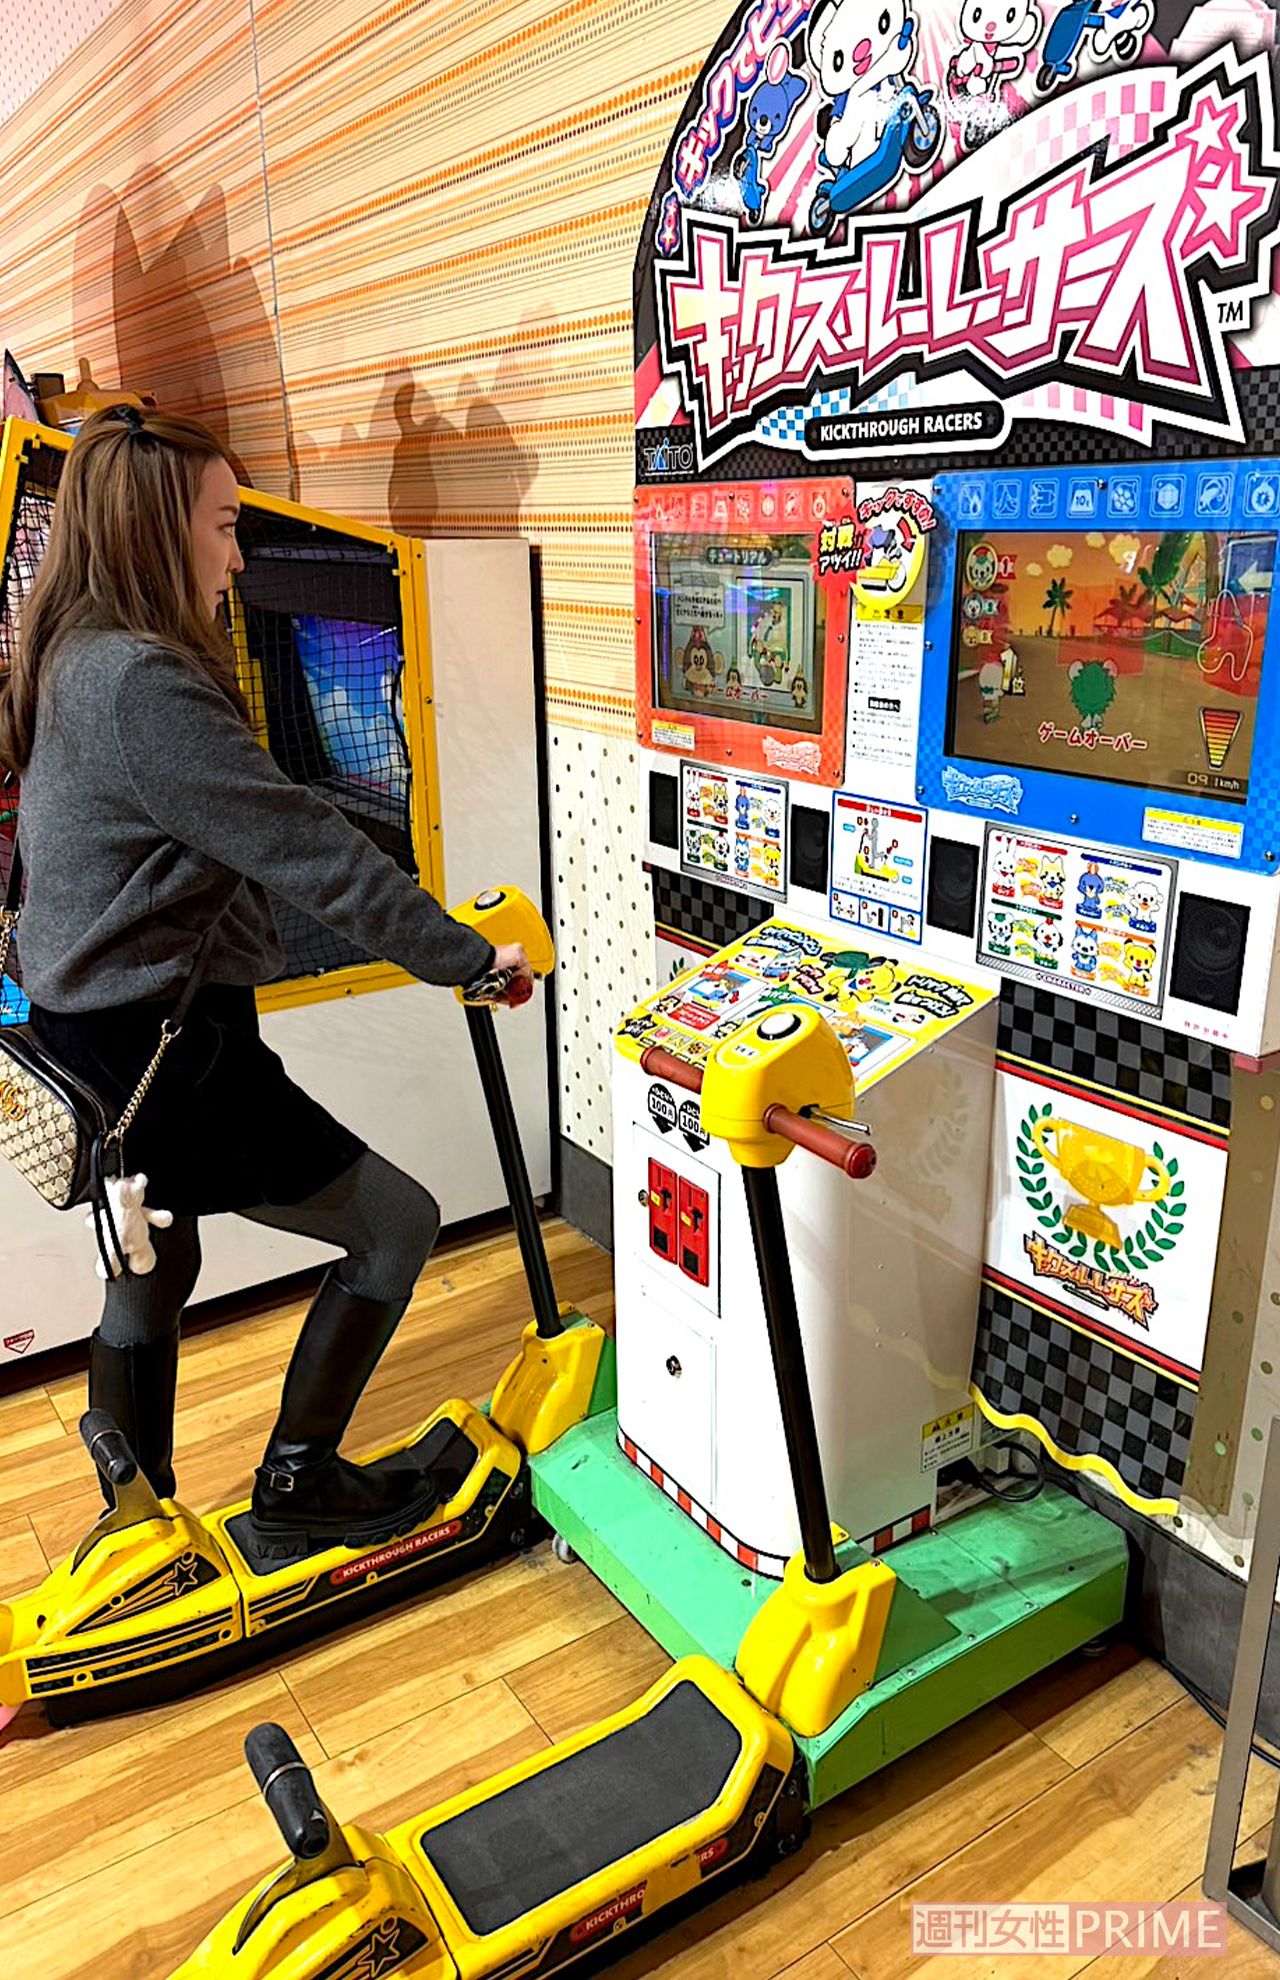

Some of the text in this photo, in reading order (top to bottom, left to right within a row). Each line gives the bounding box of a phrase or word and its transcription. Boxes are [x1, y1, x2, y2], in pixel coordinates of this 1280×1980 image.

[820, 411, 983, 442] KICKTHROUGH RACERS
[643, 437, 693, 470] TAITO
[1038, 721, 1148, 752] ゲームオーバー
[342, 1526, 450, 1578] KICKTHROUGH RACERS
